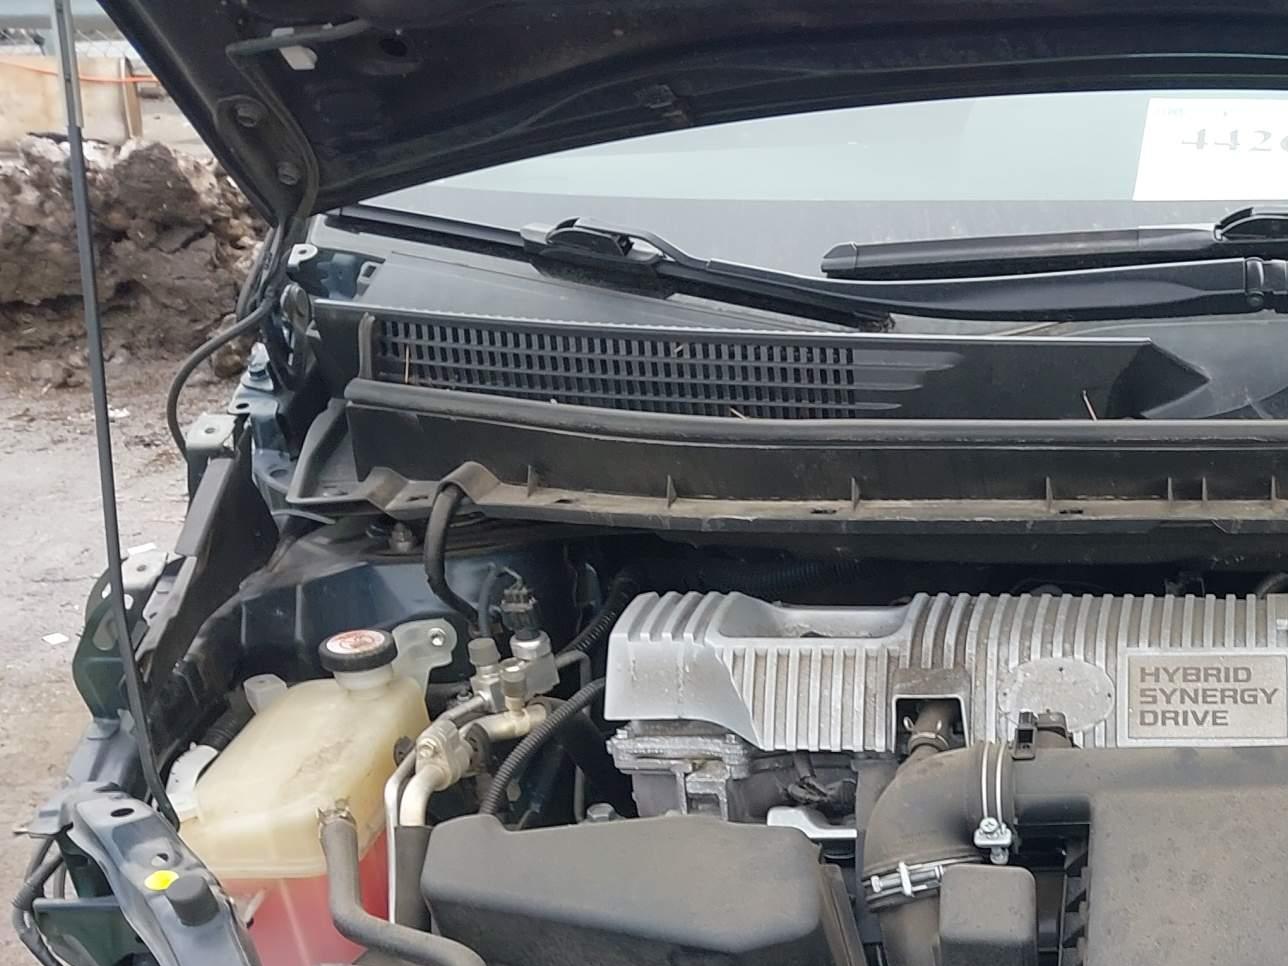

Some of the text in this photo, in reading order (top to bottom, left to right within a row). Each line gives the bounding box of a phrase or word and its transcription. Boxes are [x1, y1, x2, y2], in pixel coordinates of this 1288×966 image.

[1139, 666, 1252, 683] HYBRID
[1139, 687, 1279, 704] SYNERGY
[1139, 709, 1229, 726] DRIVE
